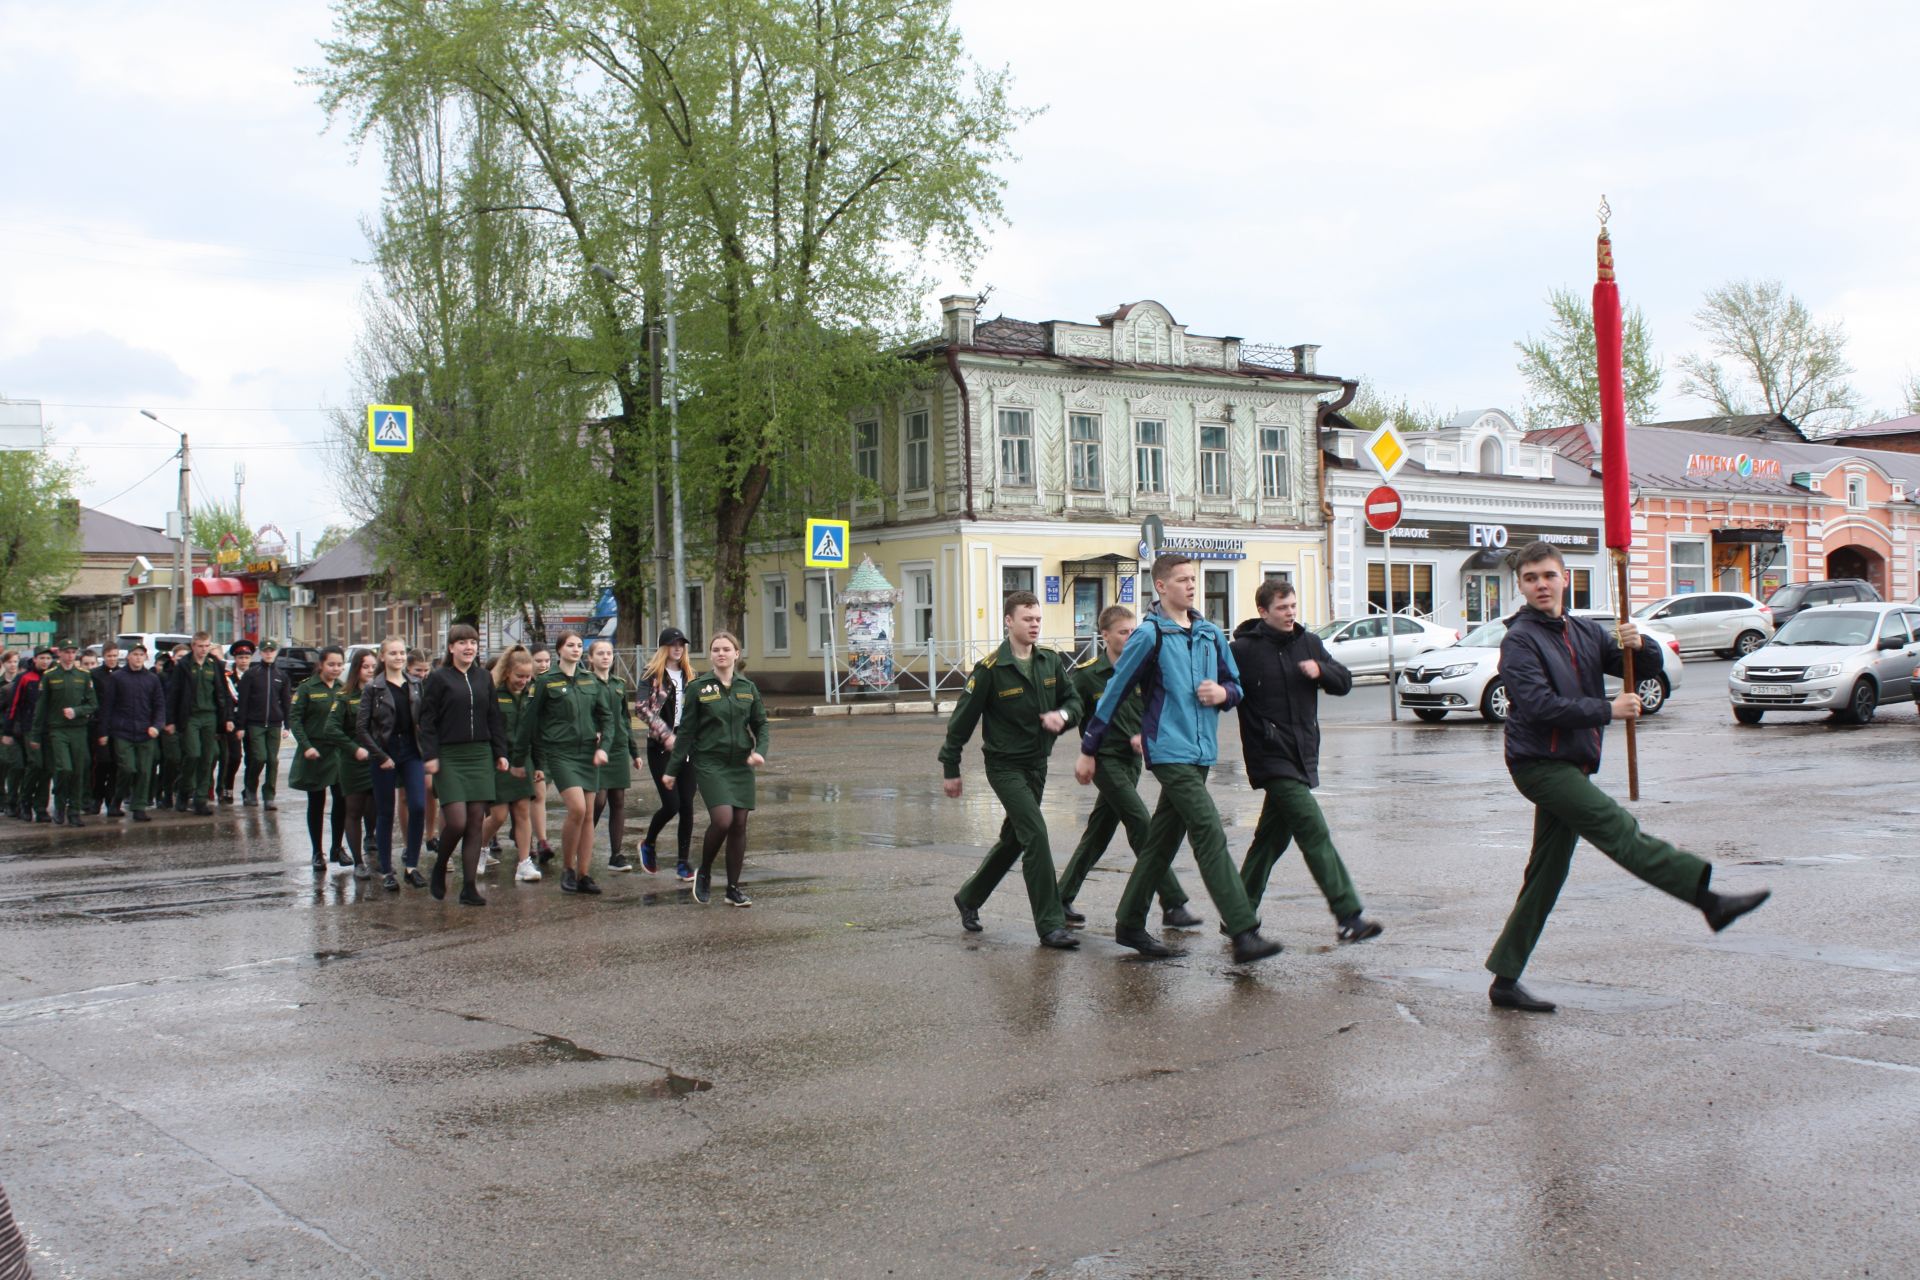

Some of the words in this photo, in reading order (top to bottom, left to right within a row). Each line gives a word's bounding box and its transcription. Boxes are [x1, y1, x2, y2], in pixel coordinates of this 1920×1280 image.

[1687, 454, 1736, 472] АПТЕКА
[1752, 459, 1780, 474] ВИТА
[1469, 524, 1508, 548] EVO
[1573, 535, 1588, 545] BAR
